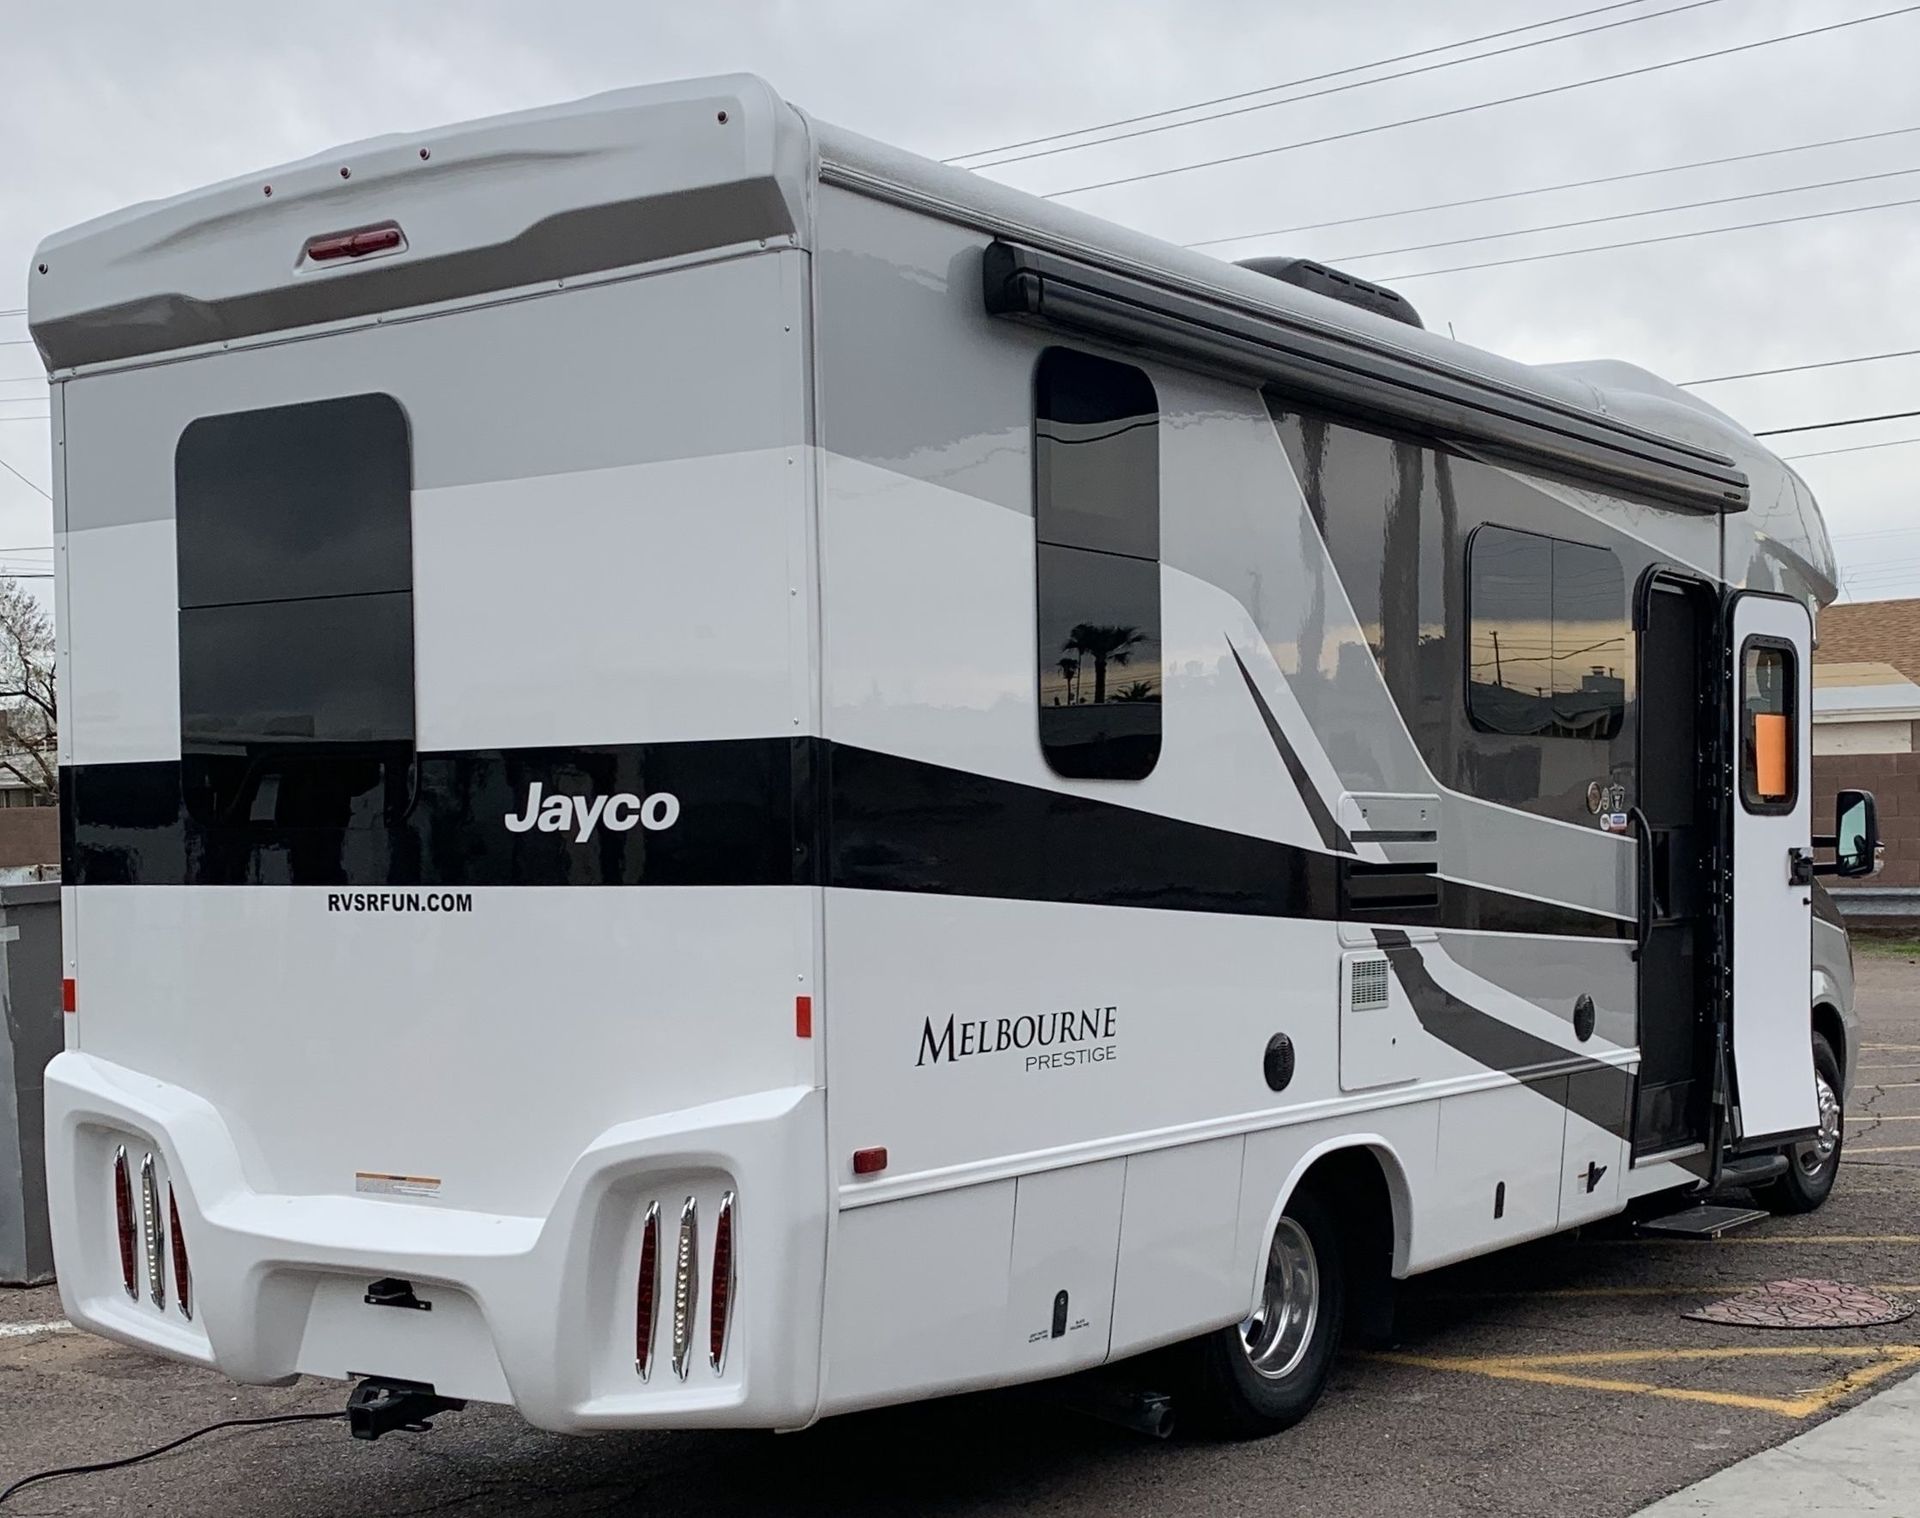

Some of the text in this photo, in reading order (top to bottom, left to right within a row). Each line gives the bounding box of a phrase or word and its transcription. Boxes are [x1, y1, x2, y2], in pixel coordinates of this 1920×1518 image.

[505, 782, 680, 843] Jayco
[328, 893, 473, 912] RVSRFUN.COM
[915, 1006, 1118, 1067] MELBOURNE
[1025, 1045, 1117, 1072] PRESTIGE
